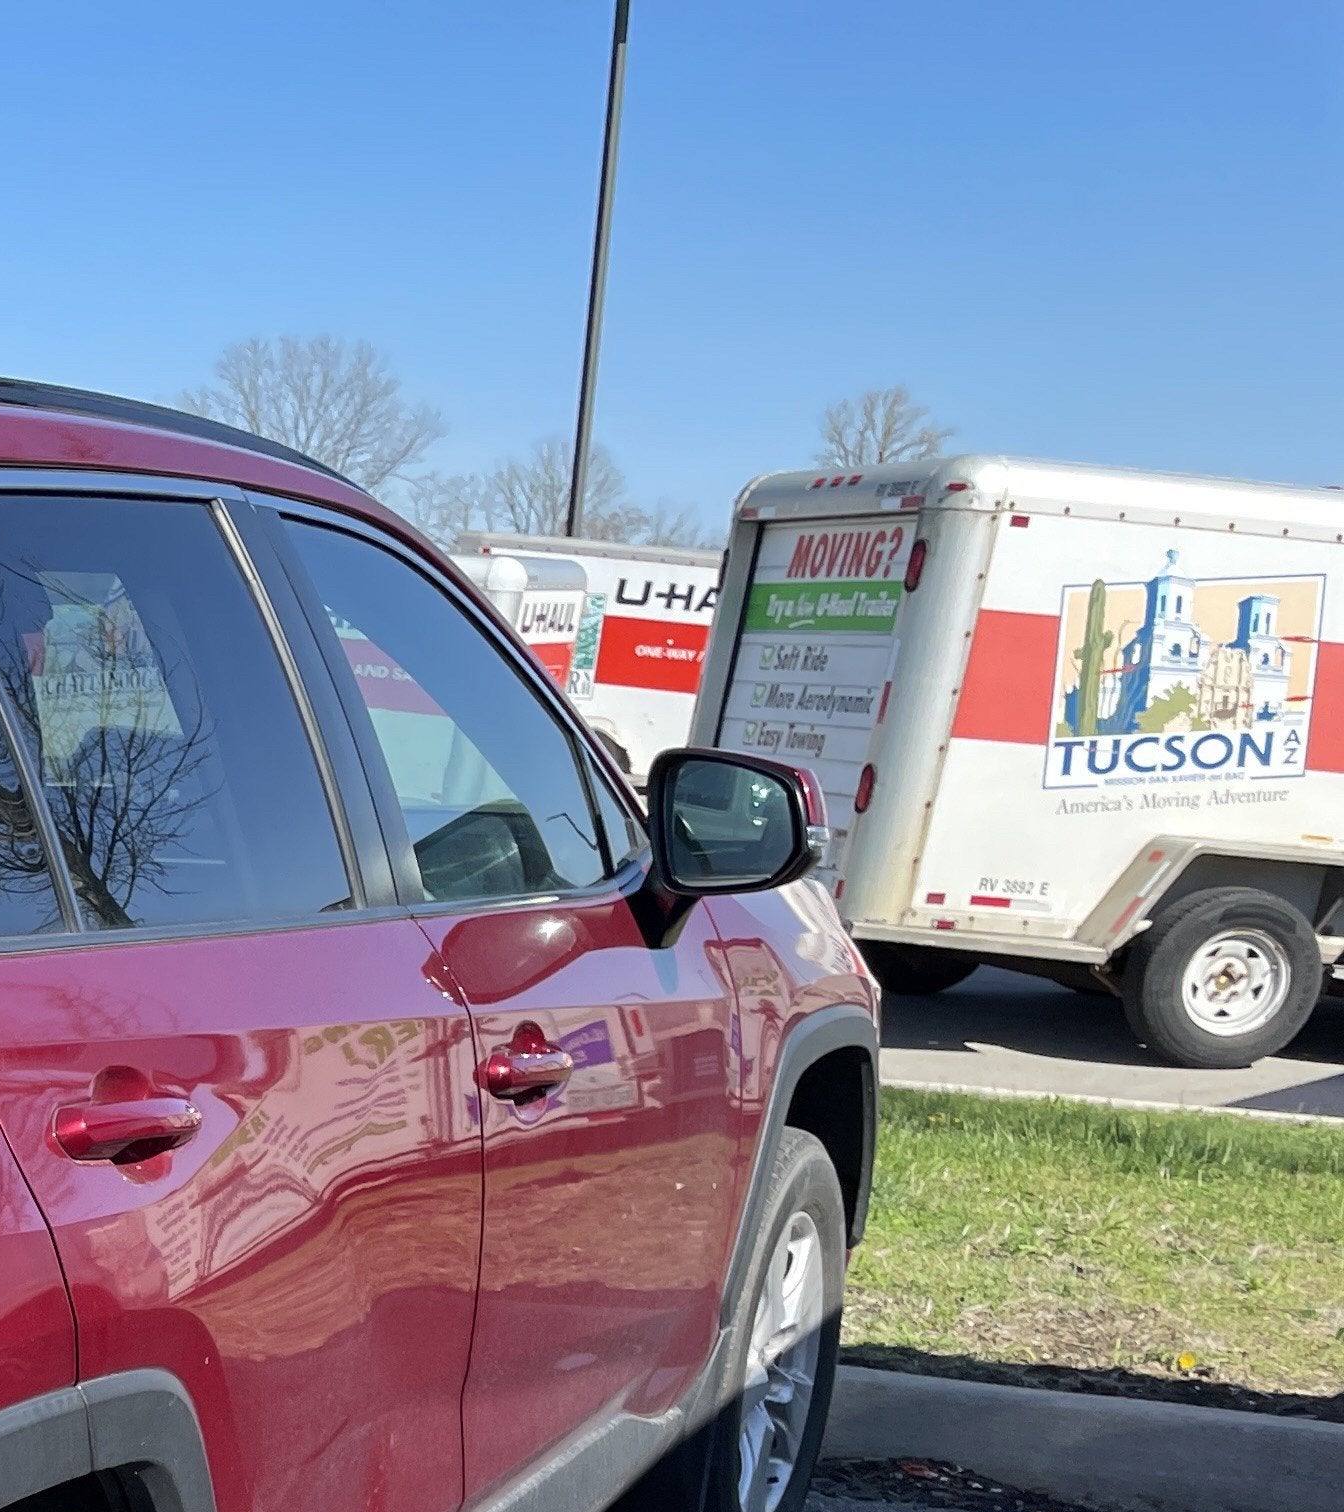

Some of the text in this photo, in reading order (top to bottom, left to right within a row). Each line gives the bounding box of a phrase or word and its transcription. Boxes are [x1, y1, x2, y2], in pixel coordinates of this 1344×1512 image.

[787, 526, 904, 579] MOVING?
[354, 664, 389, 679] AND
[773, 645, 829, 672] Soft Ride
[764, 683, 874, 719] More Aerodynamic
[757, 721, 827, 758] Easy Towing
[1054, 731, 1274, 776] TUCSON
[1055, 788, 1290, 816] America's Moving Adventure
[978, 877, 999, 892] RV
[1039, 881, 1051, 896] E
